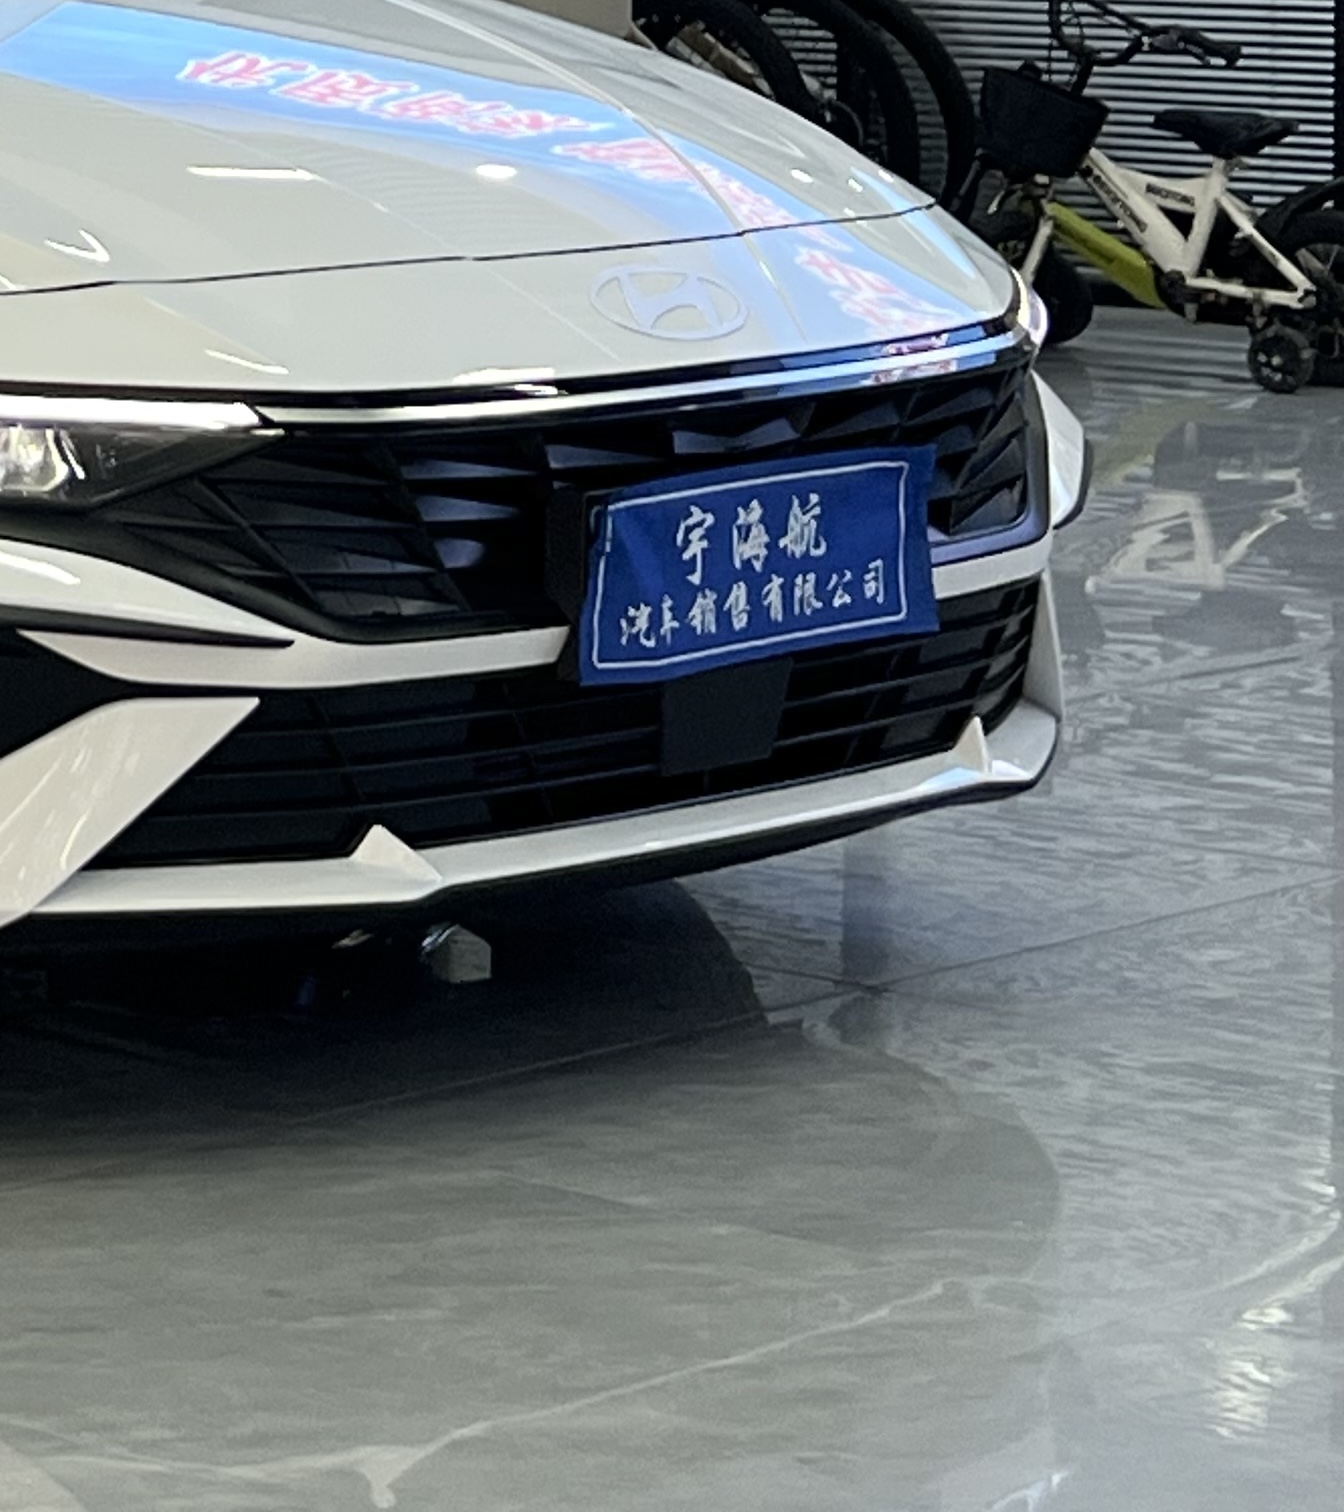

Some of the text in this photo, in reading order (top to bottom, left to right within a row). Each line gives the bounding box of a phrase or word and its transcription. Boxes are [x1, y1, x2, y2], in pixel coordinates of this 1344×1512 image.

[675, 492, 828, 586] 宇海航
[618, 558, 885, 648] 汽车销售有限公司
